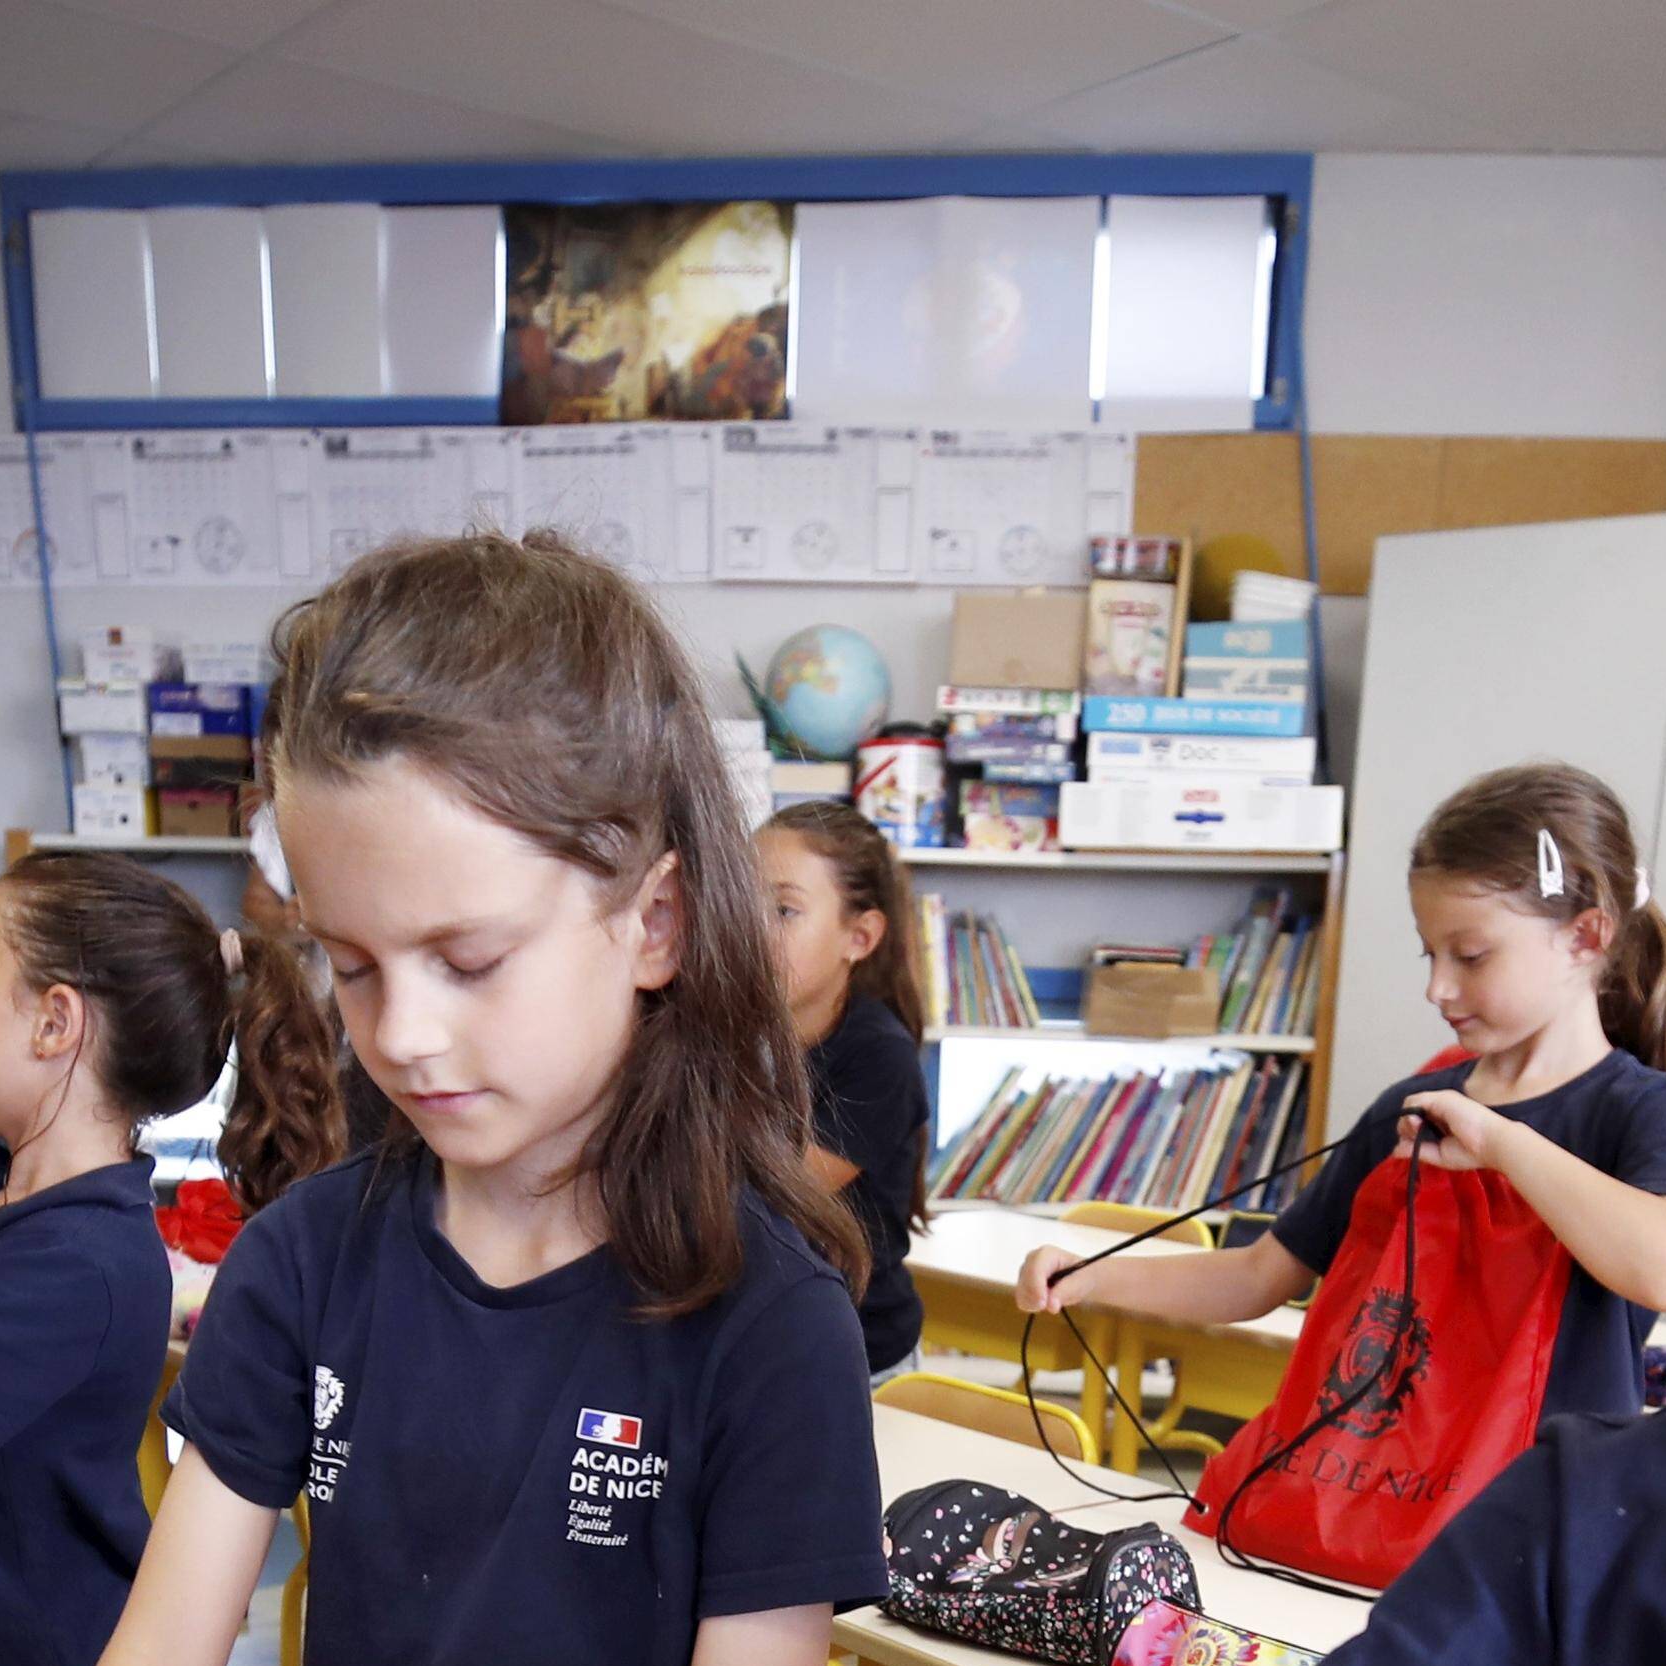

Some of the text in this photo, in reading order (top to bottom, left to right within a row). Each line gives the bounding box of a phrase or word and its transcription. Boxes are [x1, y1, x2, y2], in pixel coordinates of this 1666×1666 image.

[571, 1447, 669, 1479] ACADÉM
[1312, 1449, 1371, 1492] DE
[569, 1471, 663, 1500] DE NICE
[568, 1499, 612, 1517] Liberté
[566, 1528, 629, 1546] Fraternité
